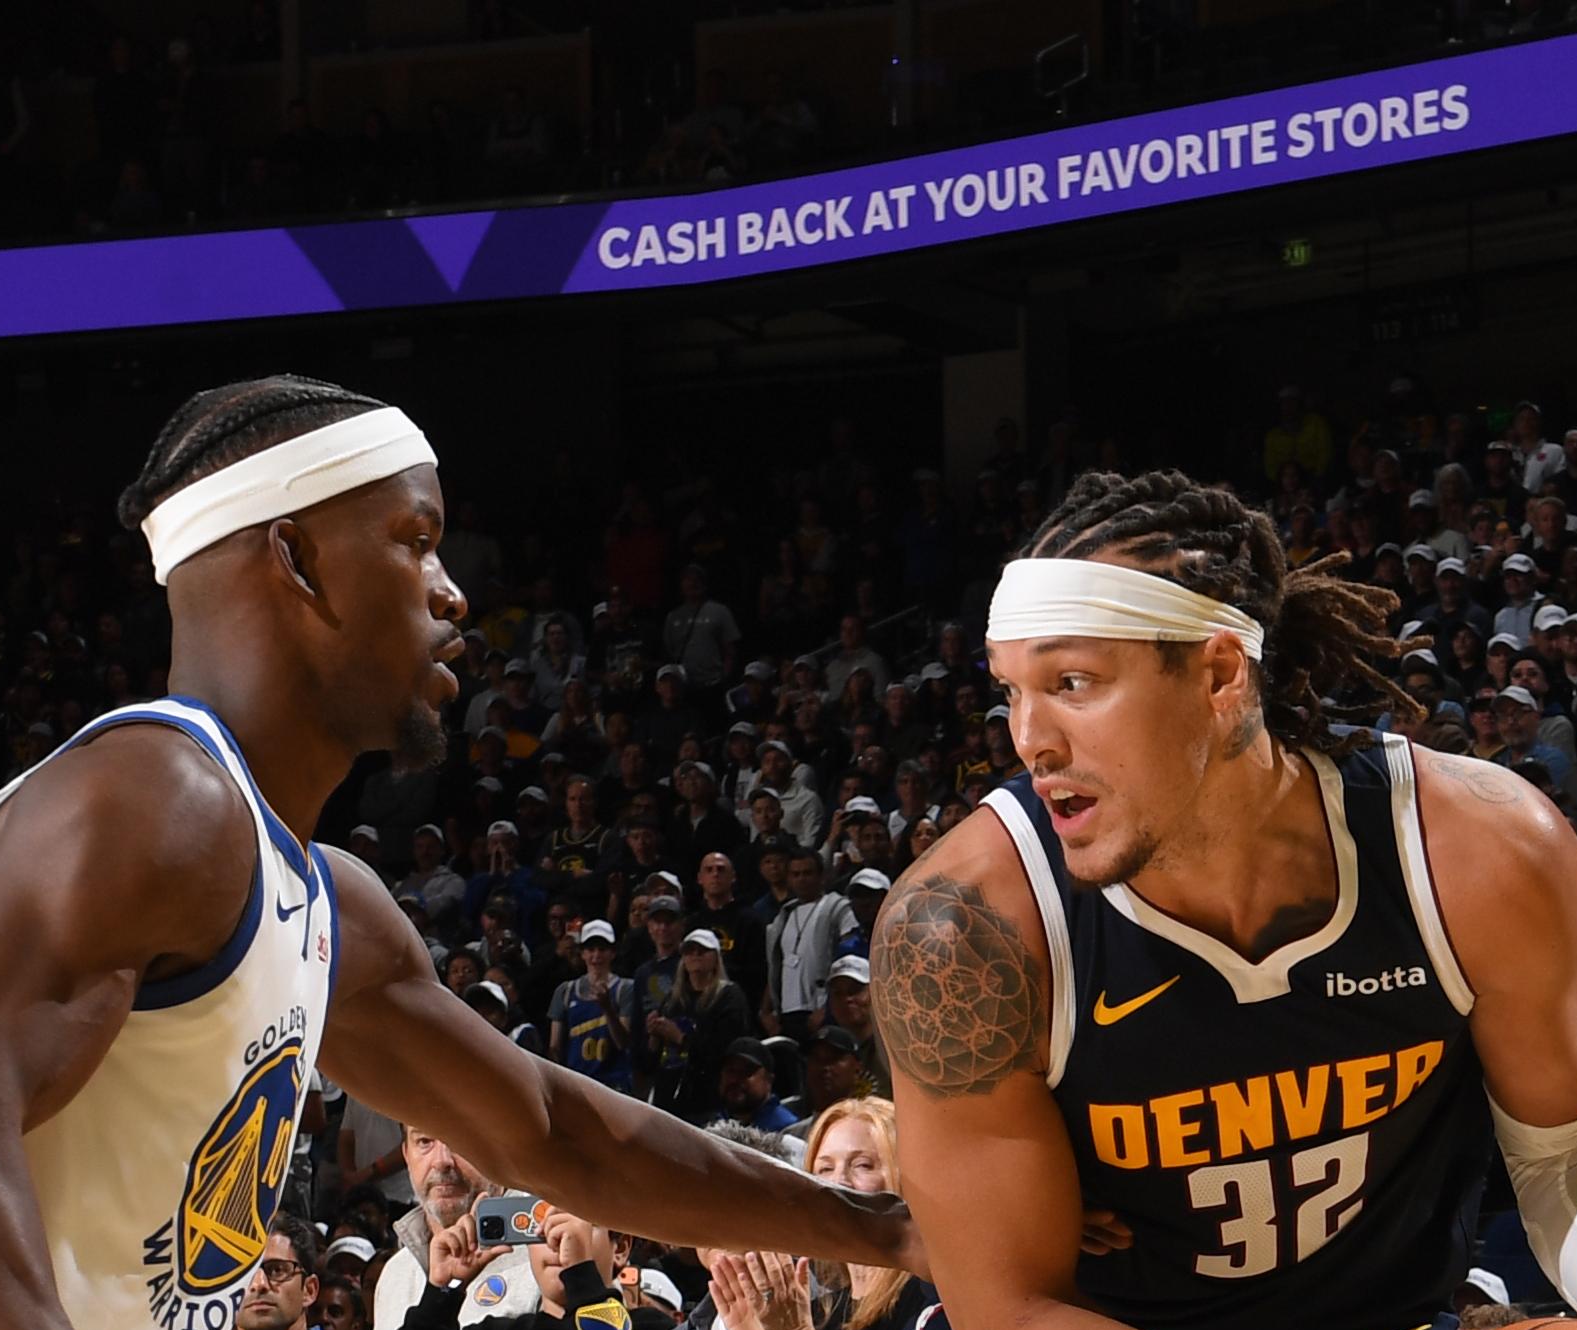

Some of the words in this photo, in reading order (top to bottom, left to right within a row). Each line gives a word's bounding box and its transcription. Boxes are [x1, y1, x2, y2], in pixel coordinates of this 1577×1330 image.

[598, 218, 726, 269] CASH
[737, 197, 854, 255] BACK
[862, 186, 916, 235] AT
[924, 164, 1049, 222] YOUR
[1058, 120, 1277, 199] FAVORITE
[1287, 85, 1469, 158] STORES
[1326, 964, 1427, 998] ibotta
[1089, 1040, 1445, 1170] DENVER
[1186, 1131, 1371, 1279] 32
